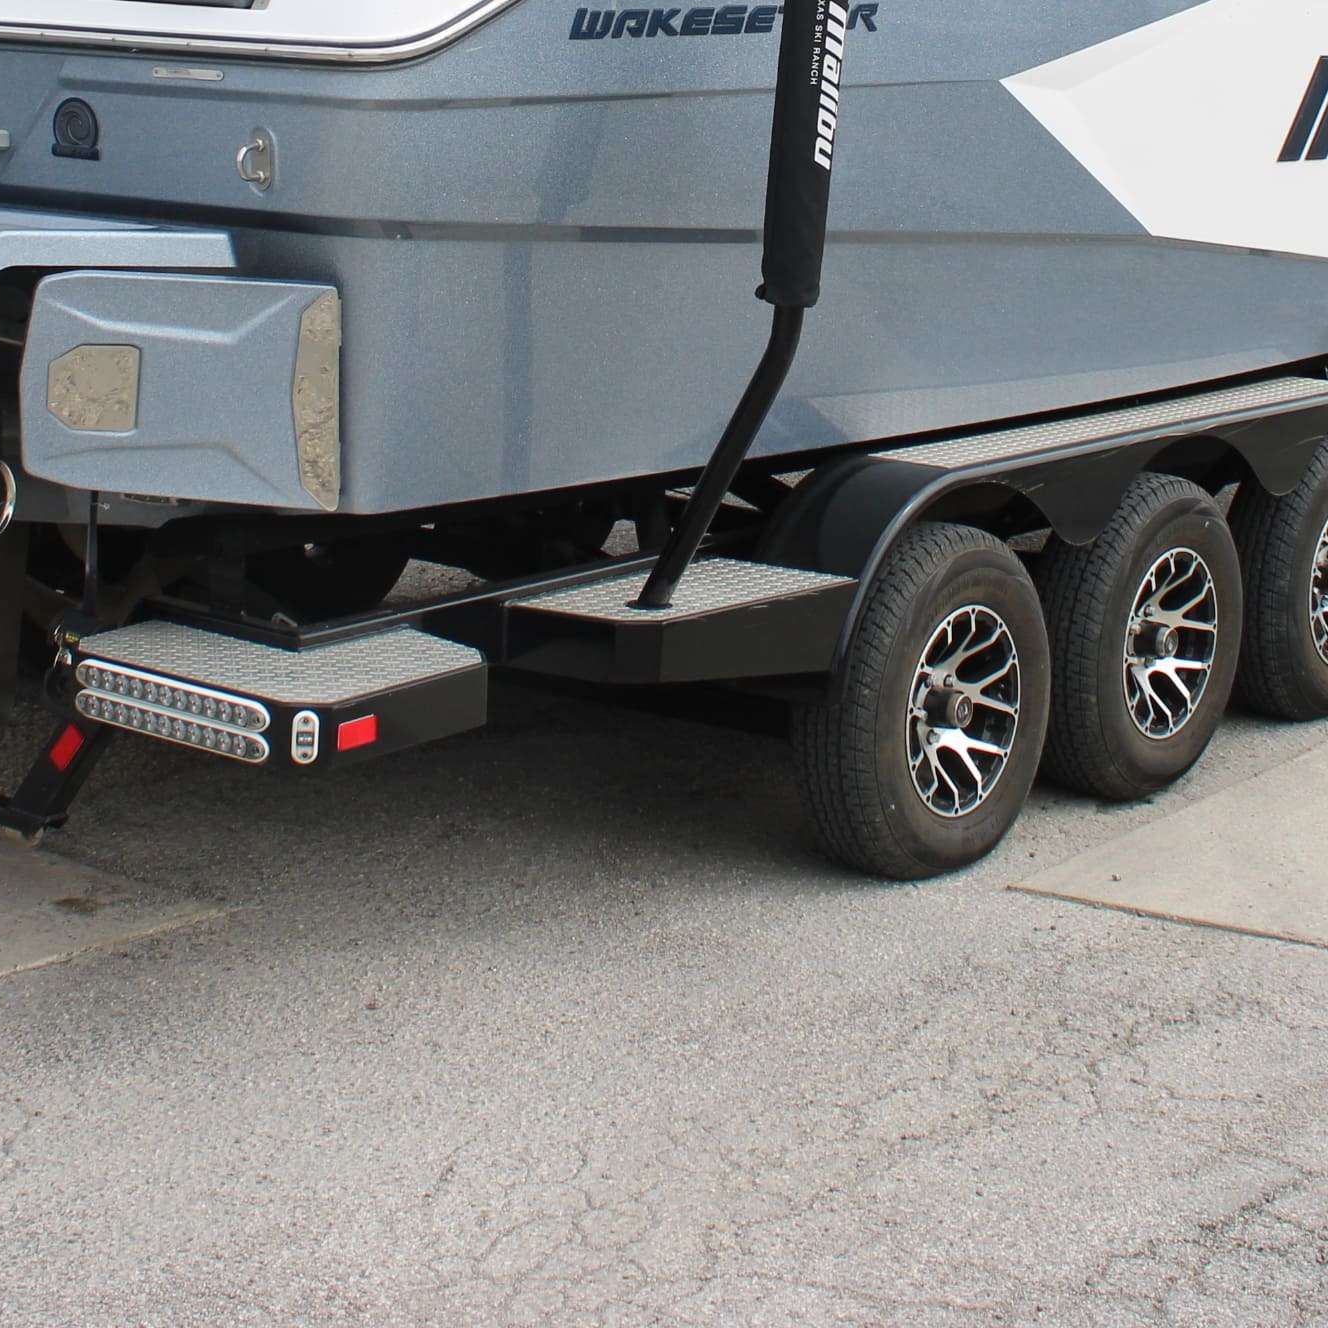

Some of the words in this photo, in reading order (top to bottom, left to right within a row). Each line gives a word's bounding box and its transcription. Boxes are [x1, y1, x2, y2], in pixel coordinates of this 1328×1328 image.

[568, 2, 879, 40] WAKESER
[814, 25, 823, 43] SKI
[810, 47, 821, 86] RANCH
